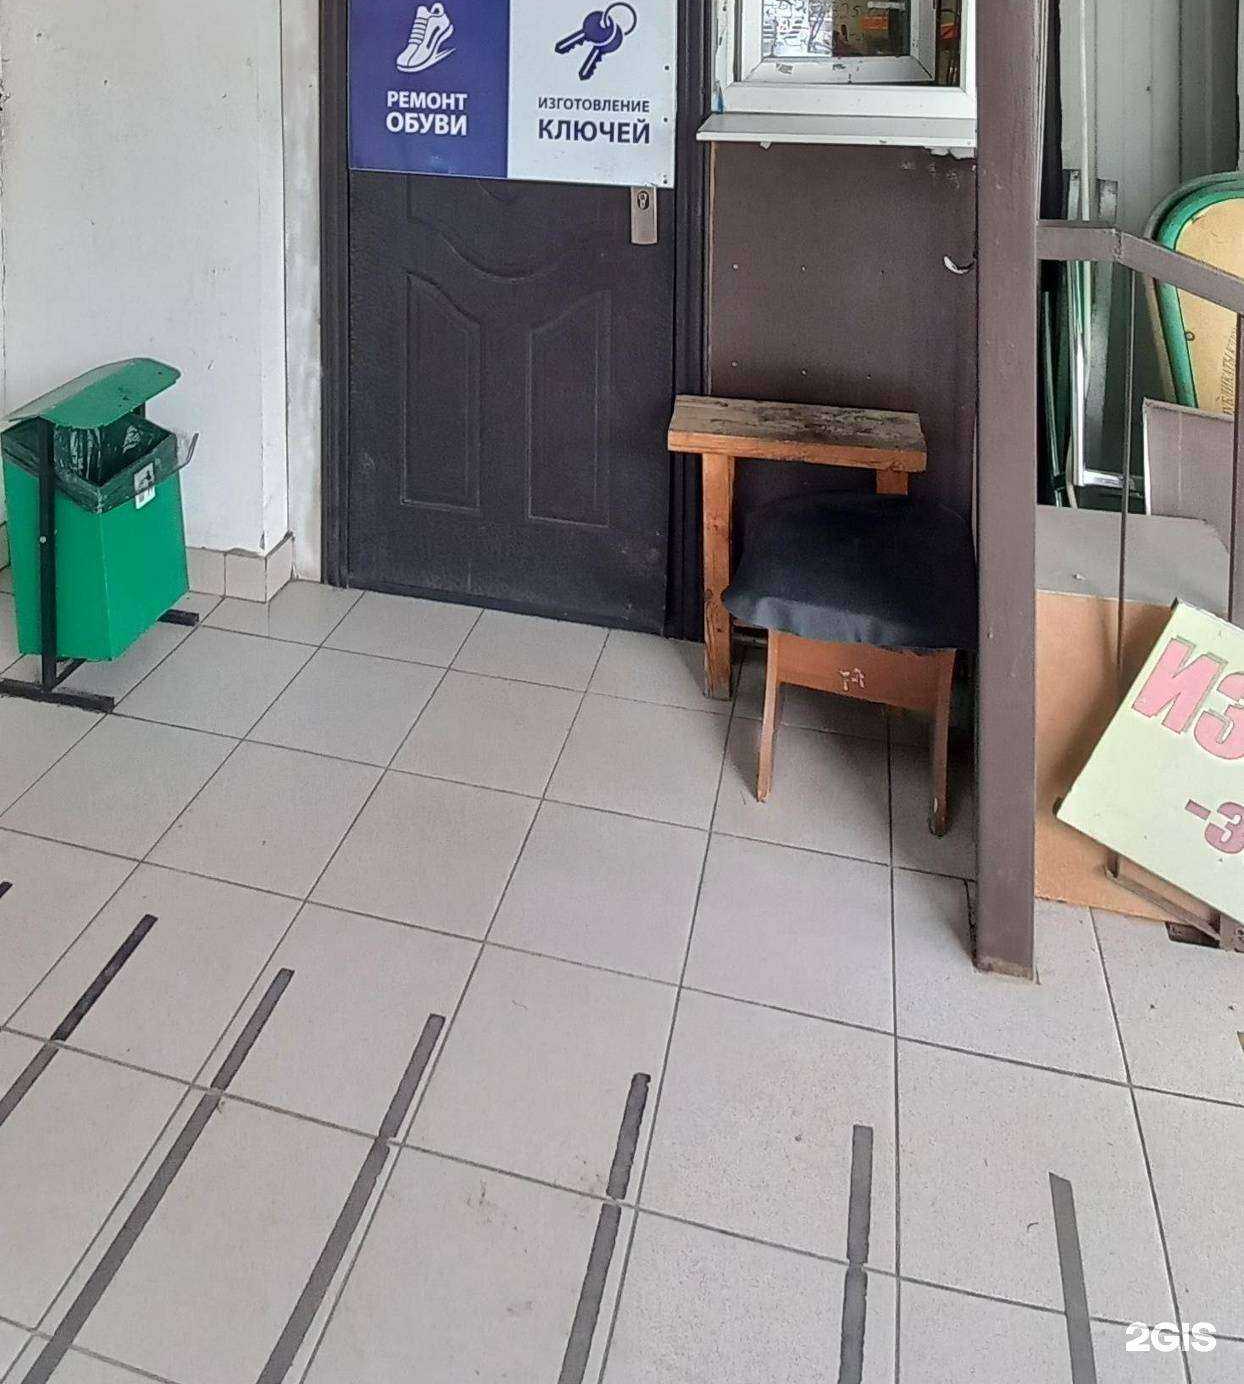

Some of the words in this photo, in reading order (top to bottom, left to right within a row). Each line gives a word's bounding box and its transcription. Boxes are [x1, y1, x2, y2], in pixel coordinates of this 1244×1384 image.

[386, 90, 468, 111] РЕМОНТ
[537, 96, 650, 113] ИЗГОТОВЛЕНИЕ
[385, 112, 468, 137] ОБУВИ
[537, 118, 651, 145] КЛЮЧЕЙ
